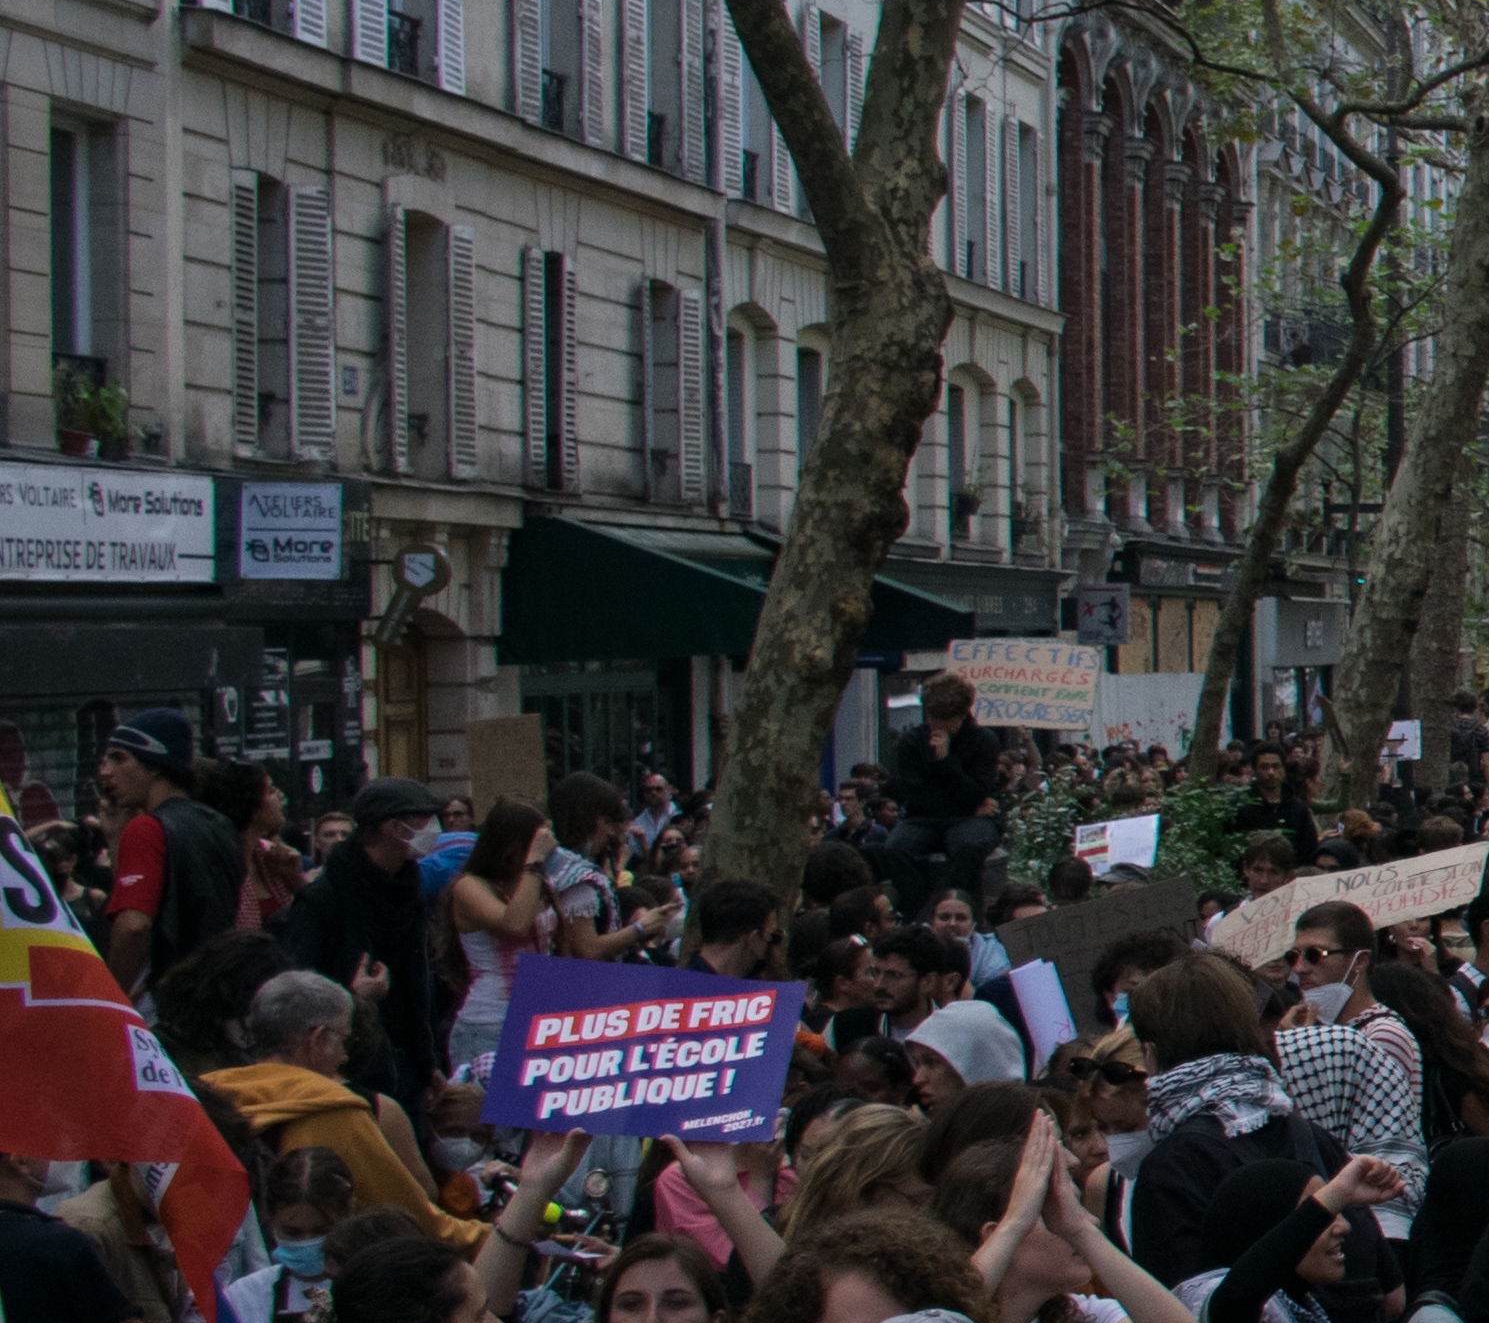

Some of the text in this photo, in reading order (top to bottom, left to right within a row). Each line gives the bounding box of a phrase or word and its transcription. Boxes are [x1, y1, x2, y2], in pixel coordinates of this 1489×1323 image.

[20, 484, 77, 508] VOLTAIRE
[108, 489, 204, 516] More Solutions
[86, 541, 106, 570] DE
[110, 542, 177, 571] TRAVAUX
[273, 538, 333, 554] More
[273, 553, 332, 563] Solutions
[1335, 864, 1400, 893] NOUS
[534, 994, 776, 1045] PLUS DE FRIC
[520, 1031, 768, 1087] POUR L'ÉCOLE
[537, 1069, 738, 1120] PUBLIQUE !
[682, 1110, 753, 1131] MELENCHON
